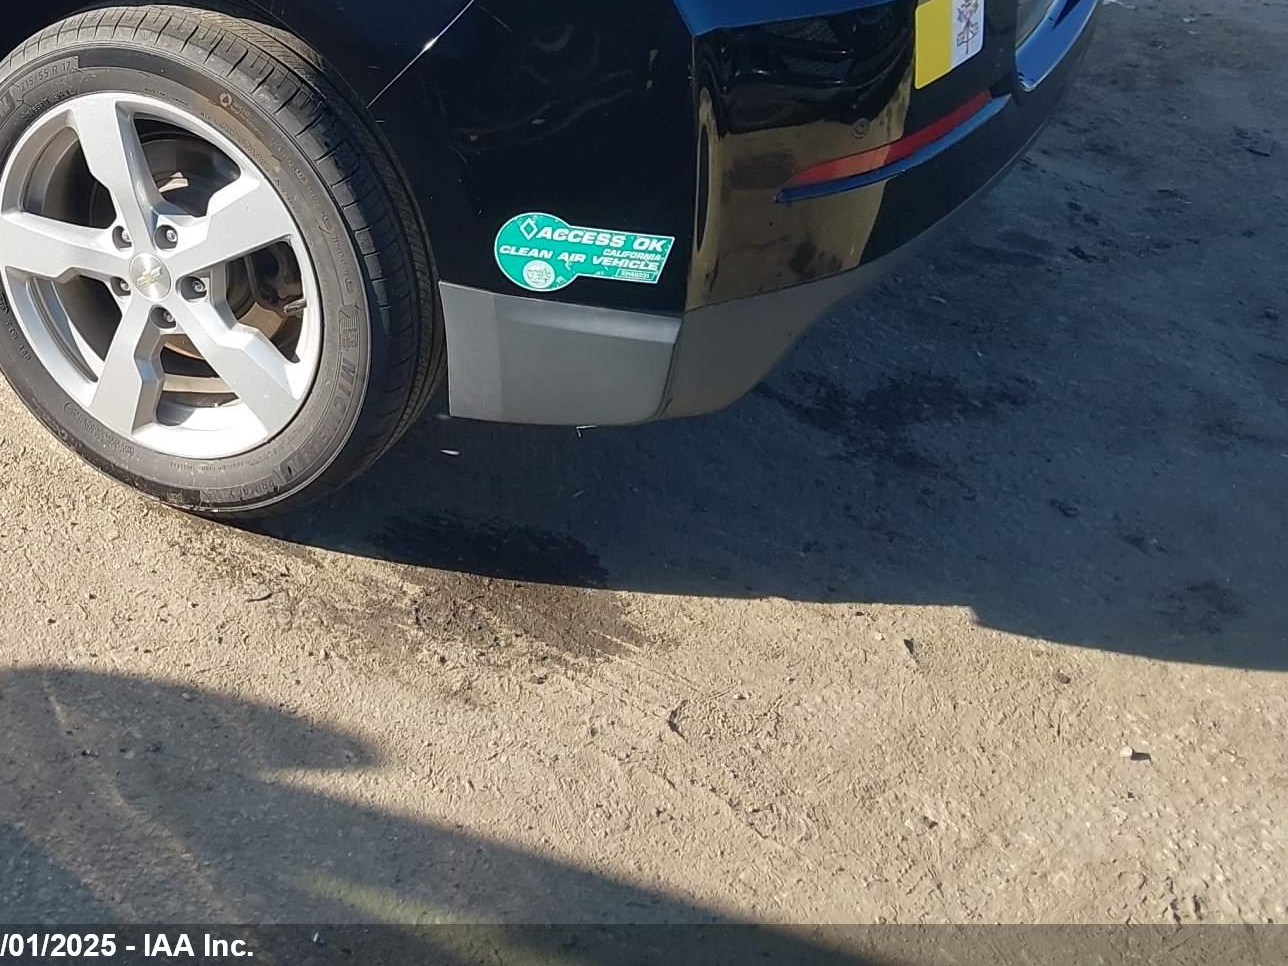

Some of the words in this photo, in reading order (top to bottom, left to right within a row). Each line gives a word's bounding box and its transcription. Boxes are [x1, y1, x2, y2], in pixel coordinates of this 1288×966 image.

[535, 226, 626, 248] ACCESS
[632, 236, 668, 252] OK
[499, 244, 553, 260] CLEAN
[557, 251, 587, 263] AIR
[592, 255, 660, 271] VEHICLE
[603, 248, 662, 262] CALIFORNIA
